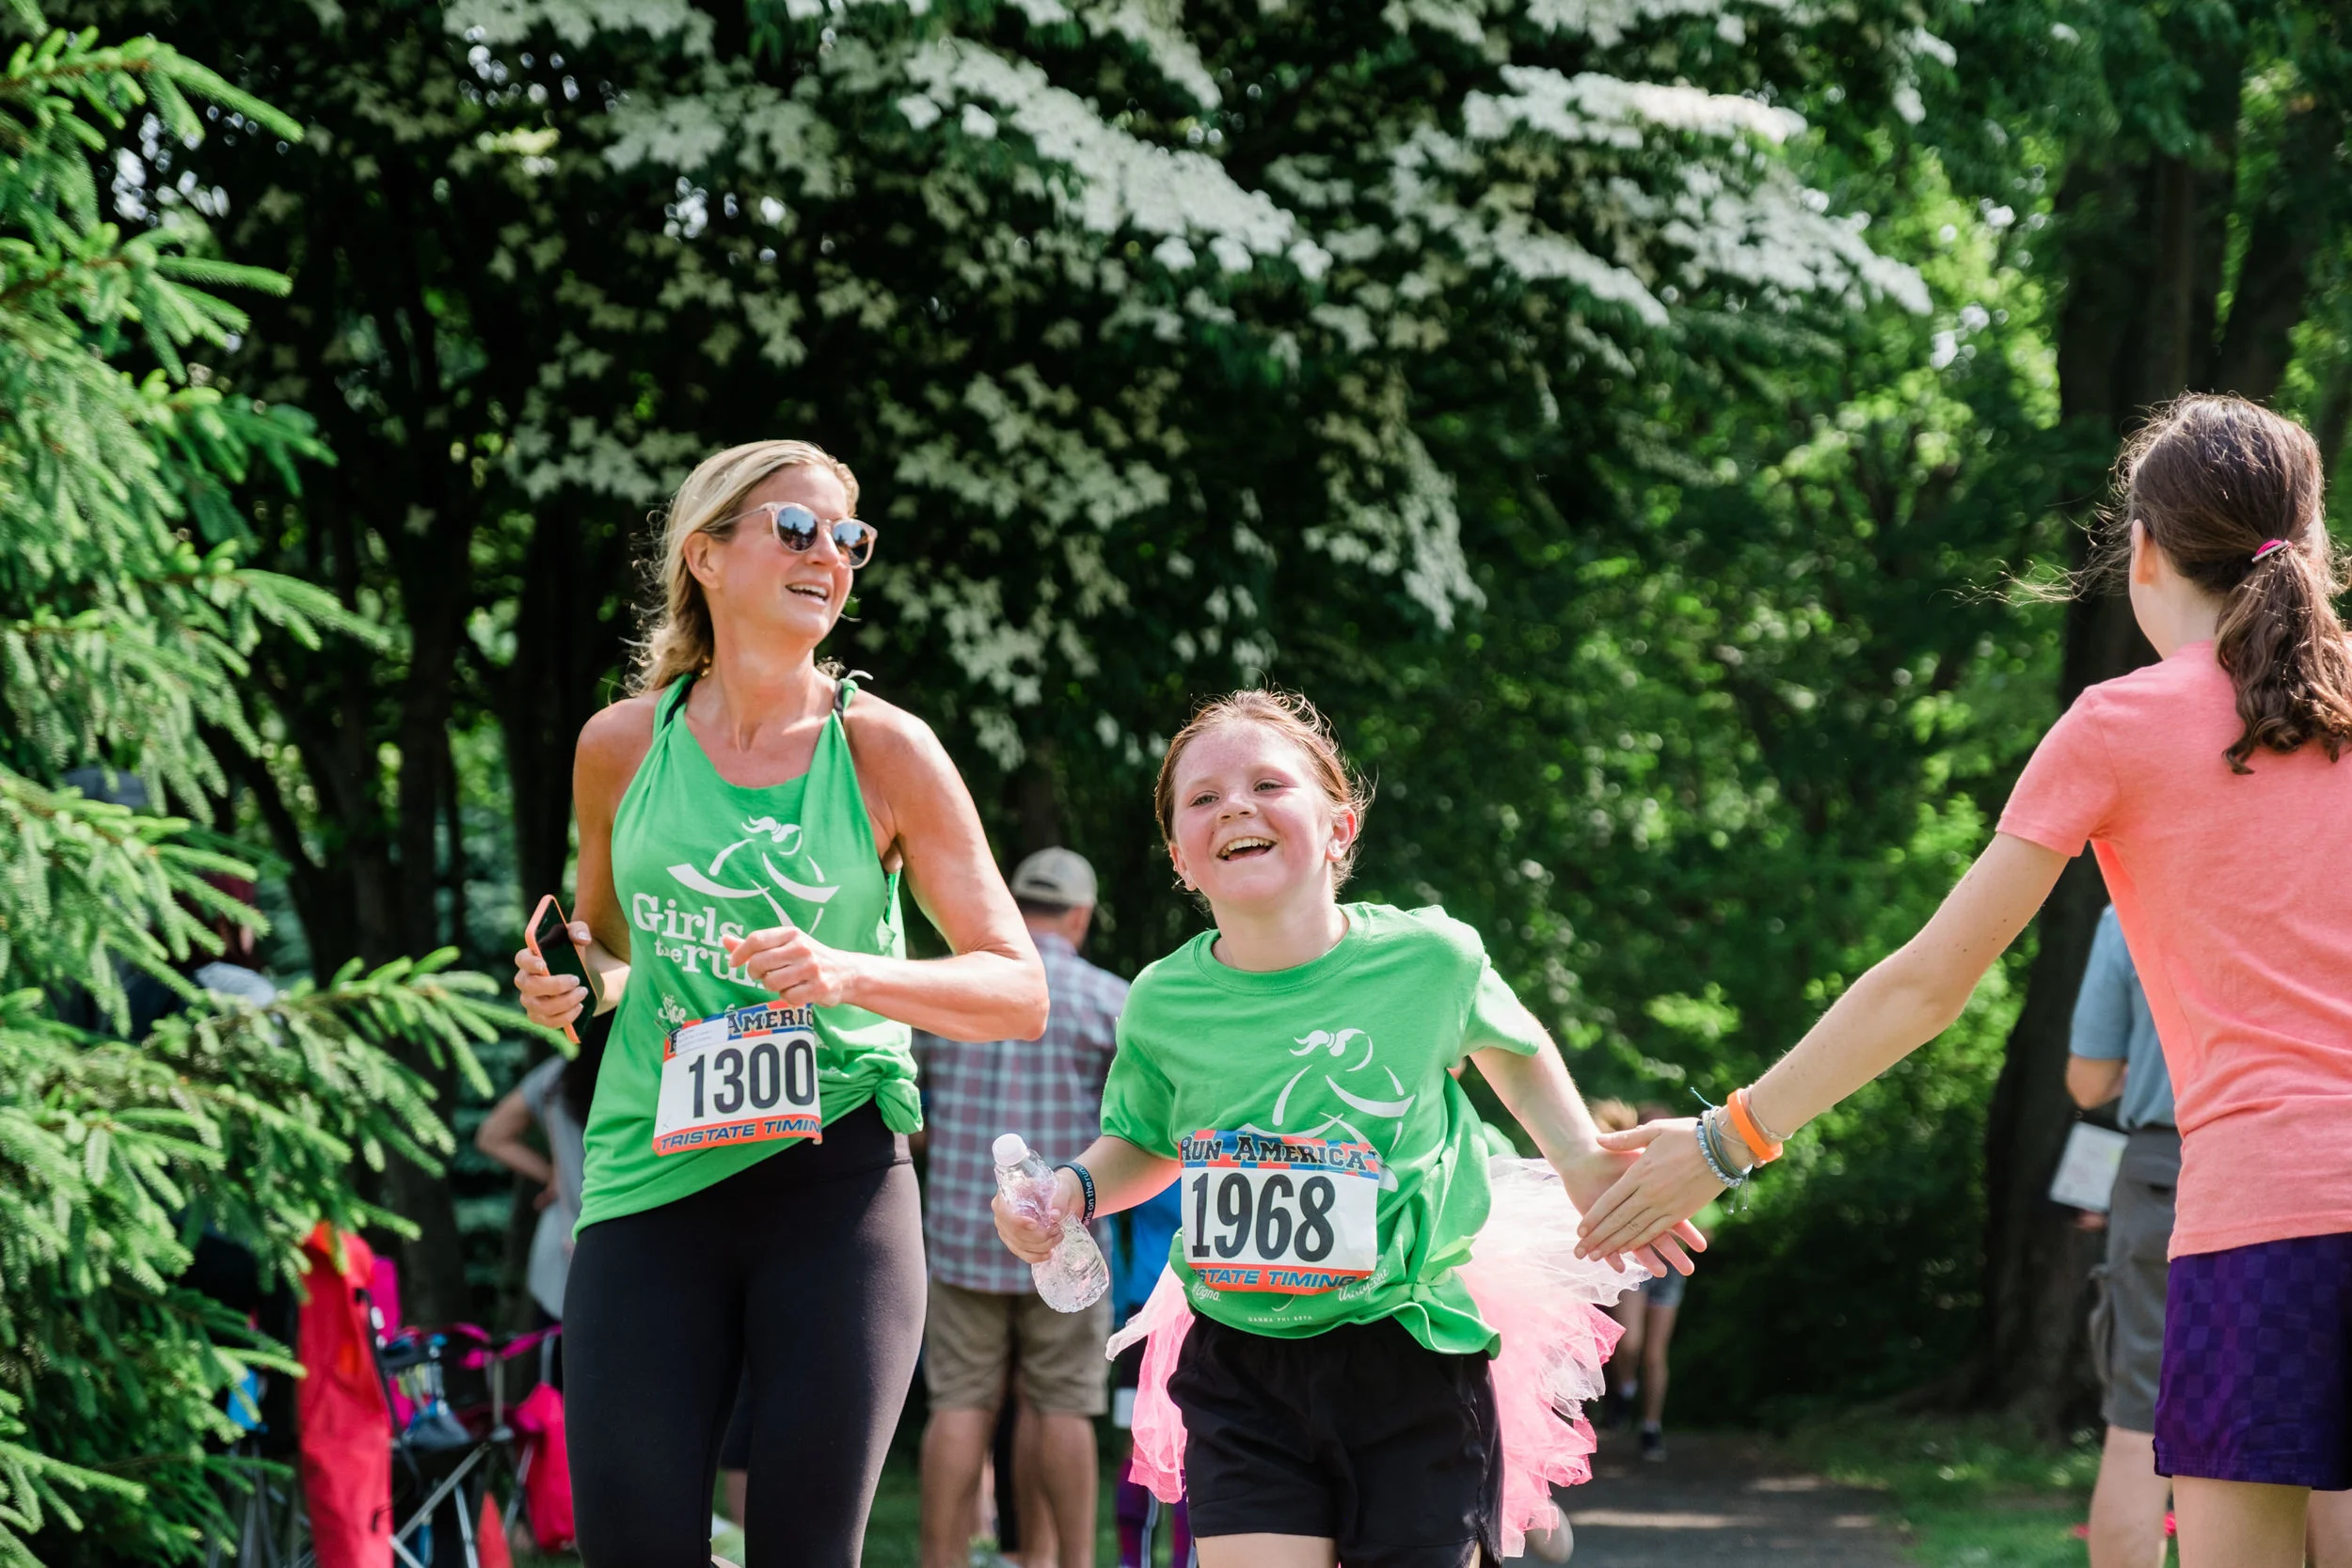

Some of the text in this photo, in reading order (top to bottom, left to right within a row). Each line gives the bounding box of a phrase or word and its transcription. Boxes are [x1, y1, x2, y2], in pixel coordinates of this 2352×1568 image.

[633, 893, 746, 948] Girls
[688, 1038, 816, 1118] 1300
[660, 1123, 755, 1150] TRISTATE
[1182, 1135, 1368, 1171] RUN AMERICA
[1086, 1181, 1094, 1197] the
[1192, 1172, 1336, 1262] 1968
[1195, 1268, 1358, 1288] STATE TIMING
